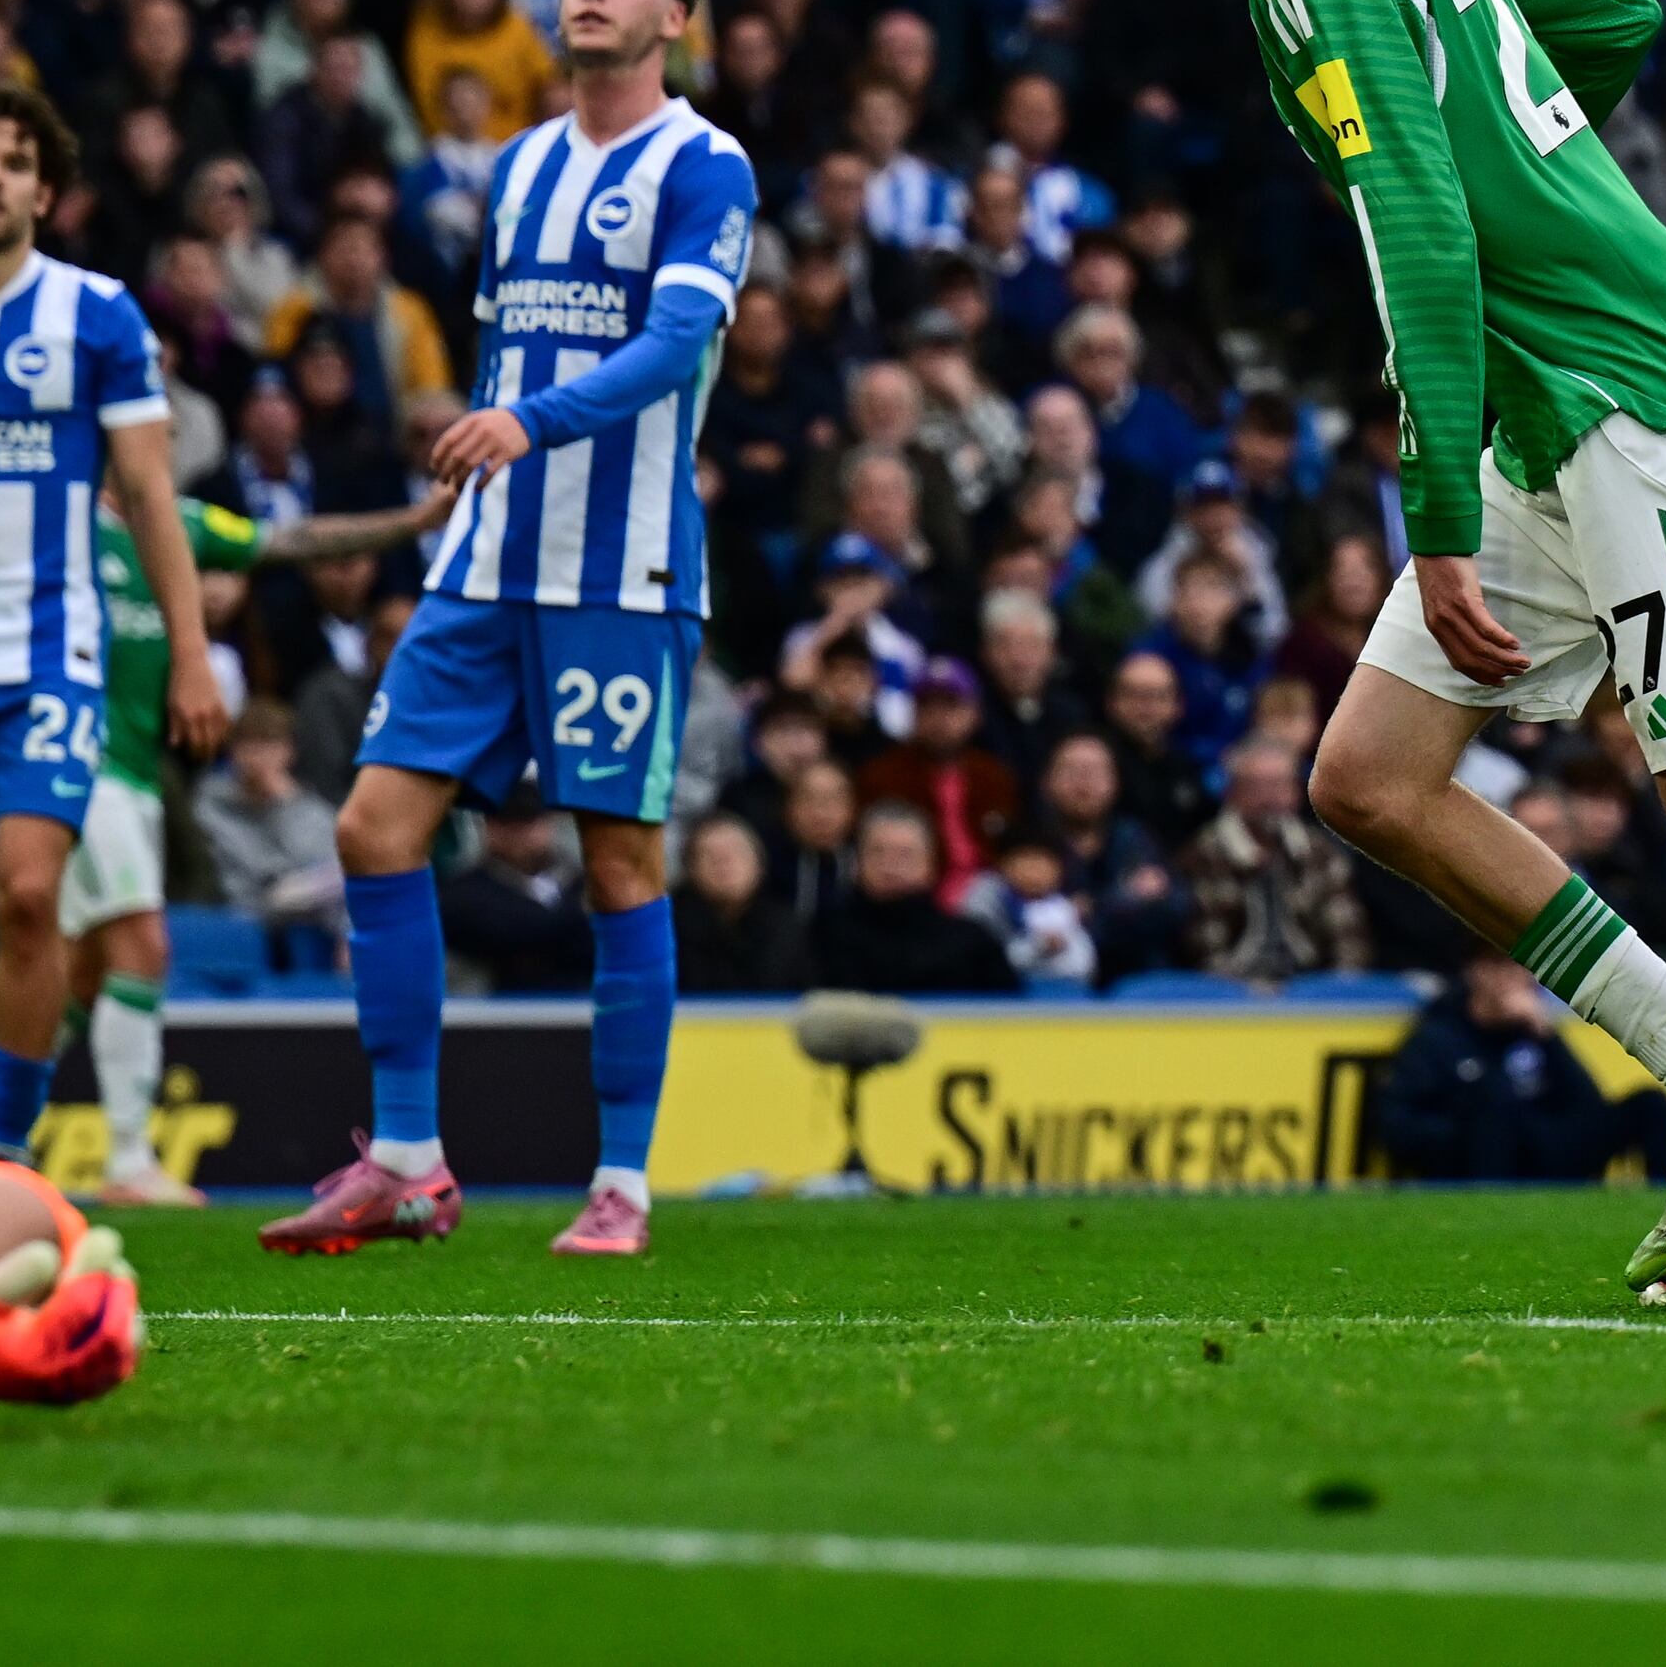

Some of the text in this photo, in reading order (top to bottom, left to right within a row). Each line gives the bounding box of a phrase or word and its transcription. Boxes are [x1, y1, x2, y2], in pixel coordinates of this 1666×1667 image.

[495, 279, 626, 311] AMERICAN
[502, 306, 629, 339] EXPRESS
[23, 692, 102, 770] 24
[554, 667, 653, 752] 29
[931, 1069, 1303, 1192] SNICKERS
